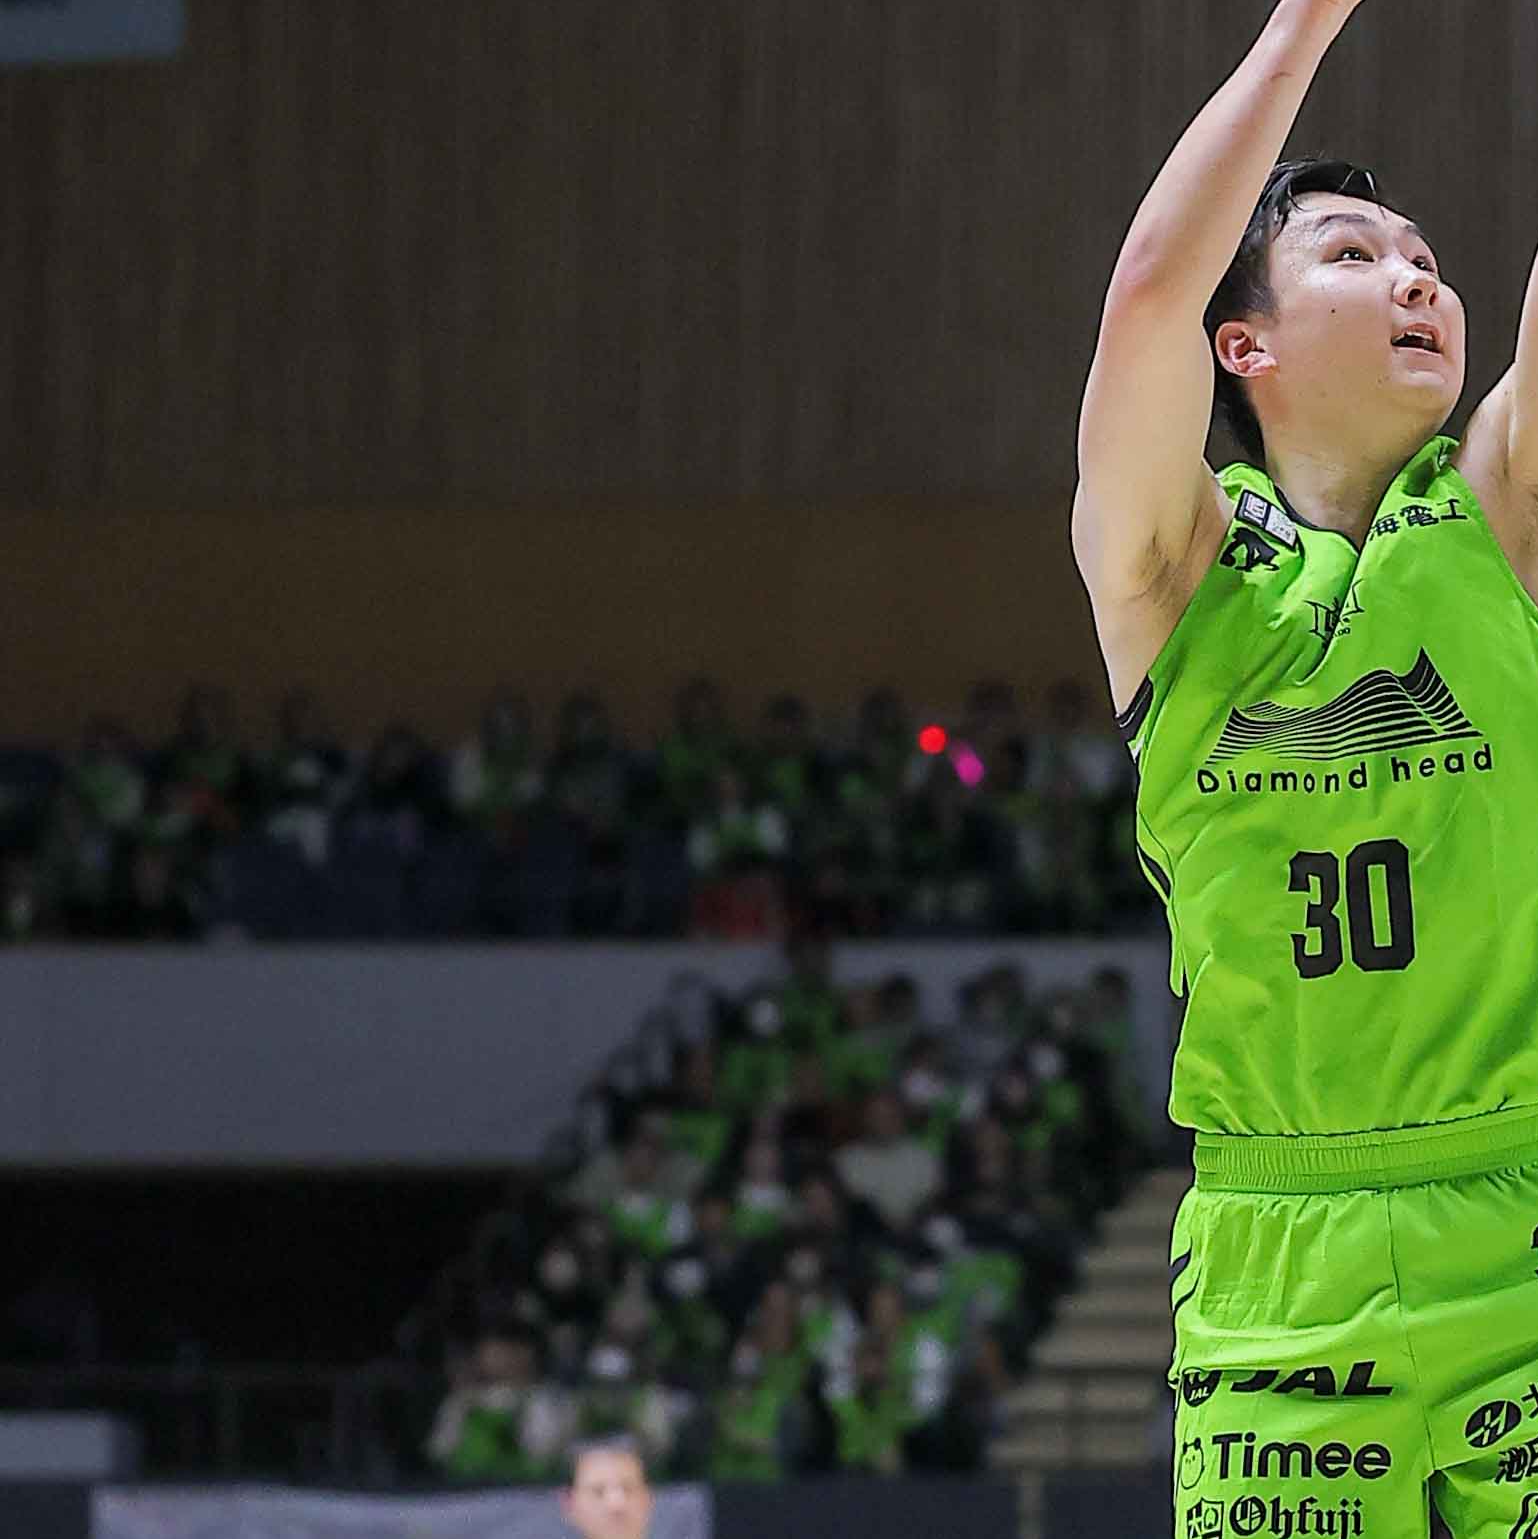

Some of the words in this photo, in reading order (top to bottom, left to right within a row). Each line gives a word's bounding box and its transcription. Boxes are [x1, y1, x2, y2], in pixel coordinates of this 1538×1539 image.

[1197, 760, 1368, 794] Diamond
[1390, 743, 1493, 783] head
[1287, 838, 1416, 979] 30
[1212, 1432, 1392, 1480] Timee
